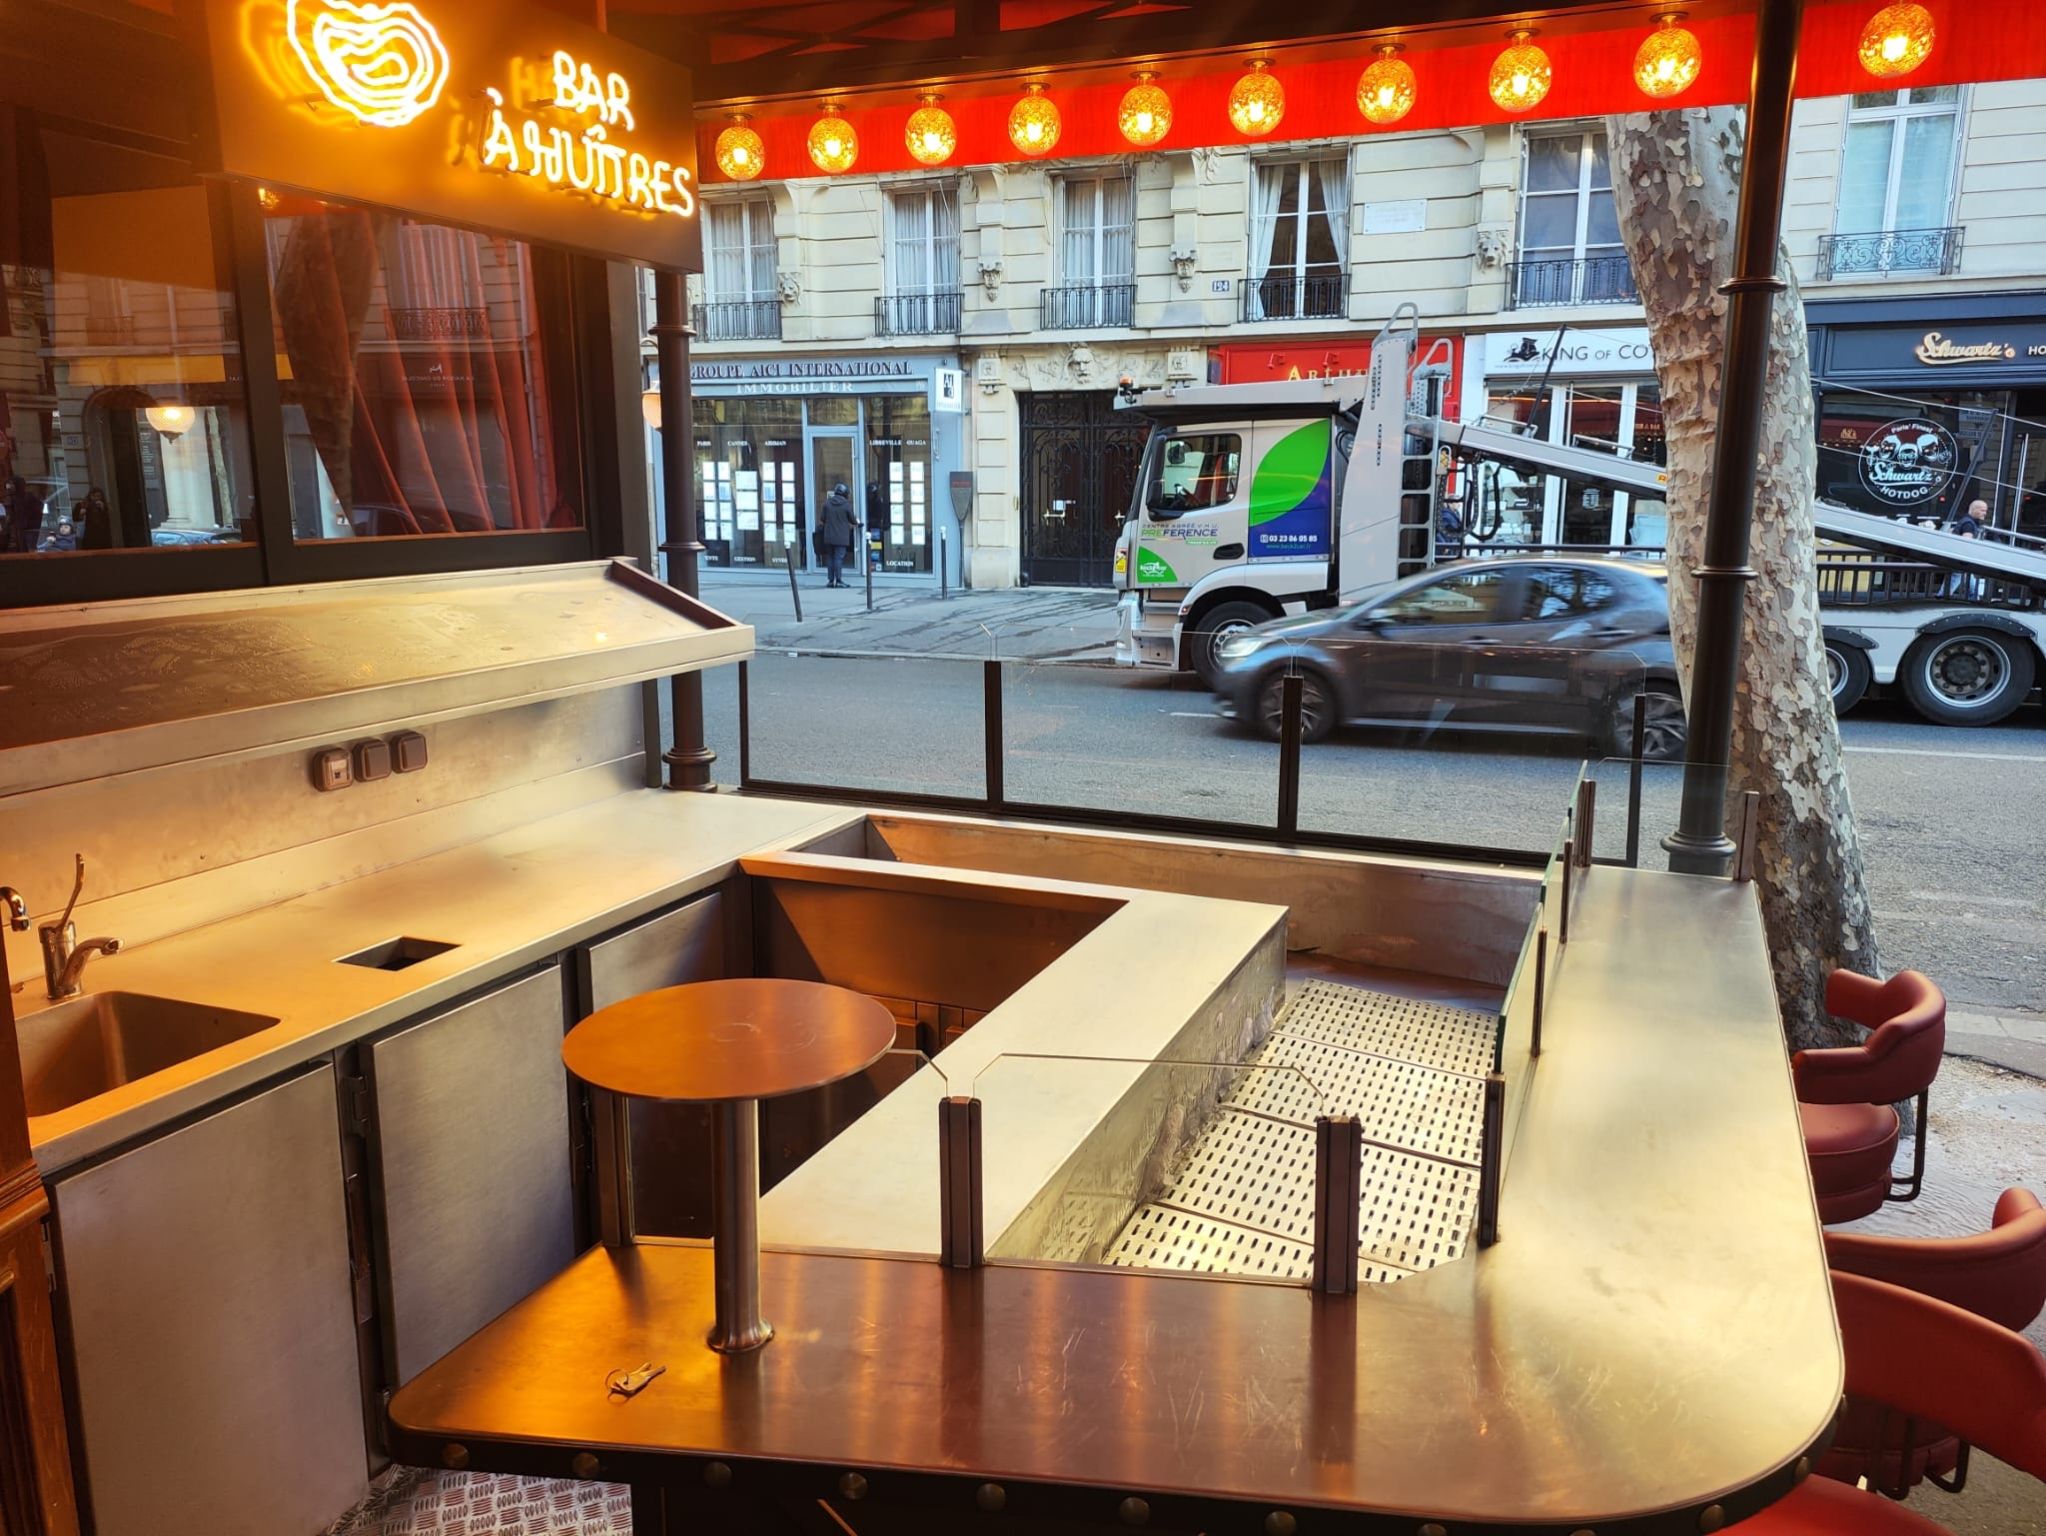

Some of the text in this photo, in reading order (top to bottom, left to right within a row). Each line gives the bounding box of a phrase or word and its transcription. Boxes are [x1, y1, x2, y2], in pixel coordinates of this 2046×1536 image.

[552, 50, 635, 132] BAR
[483, 86, 694, 217] À HUÎTRES
[1594, 350, 1611, 360] OF
[1618, 344, 1650, 359] CO
[750, 363, 781, 378] AICI
[789, 361, 912, 378] INTERNATIONAL
[736, 381, 853, 394] IMMOBILIER
[1880, 486, 1928, 499] HOTDOG
